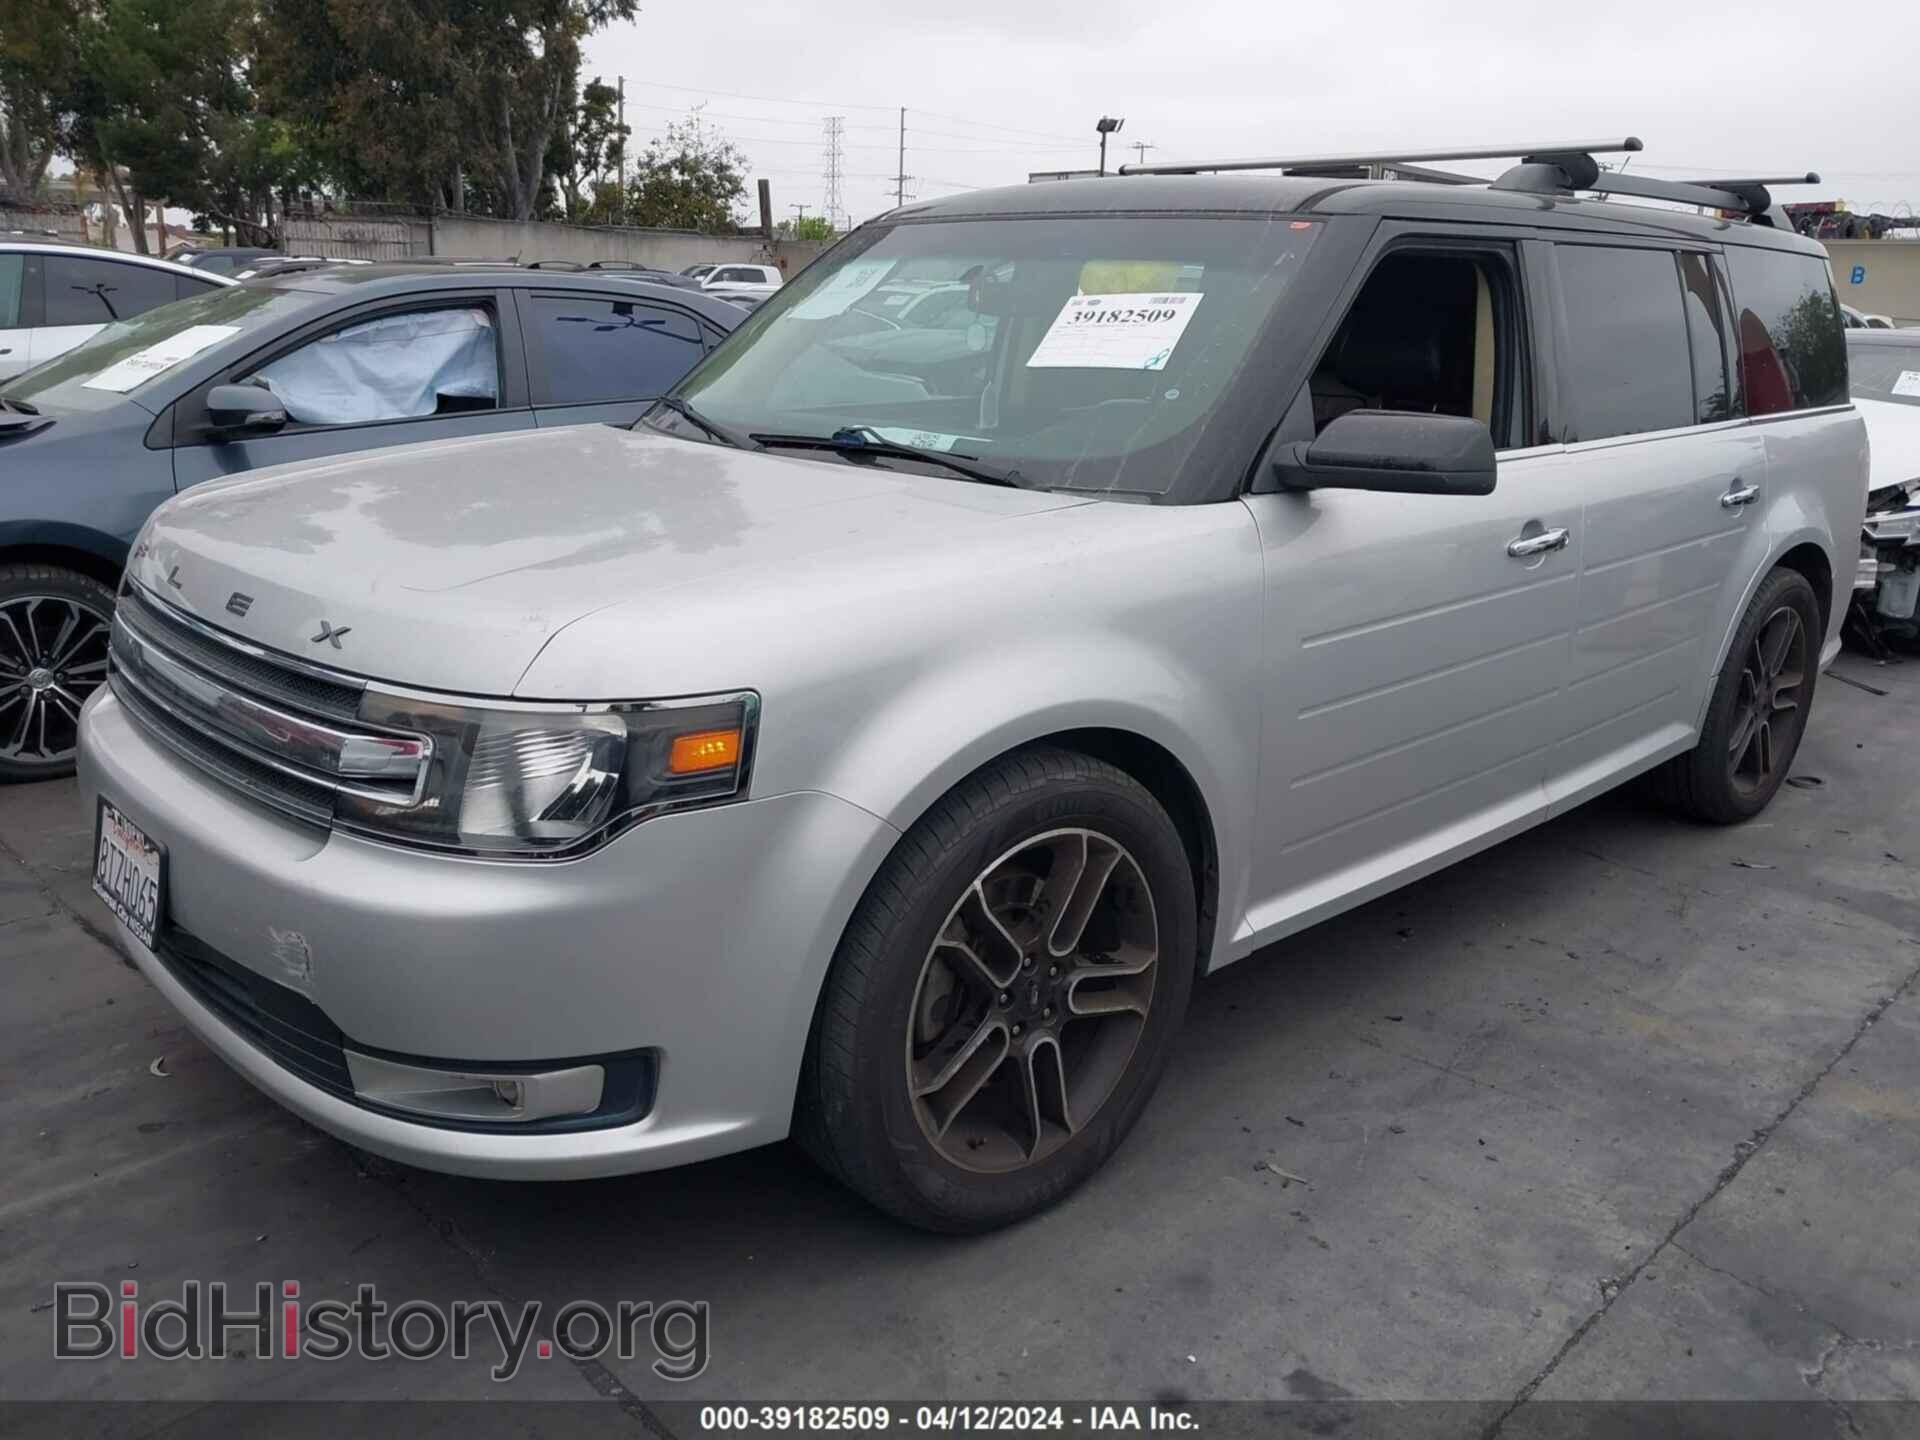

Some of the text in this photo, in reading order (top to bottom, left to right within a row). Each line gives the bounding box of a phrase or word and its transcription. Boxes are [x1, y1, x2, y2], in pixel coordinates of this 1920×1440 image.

[1851, 266, 1865, 284] B
[1067, 309, 1176, 325] 39182509
[98, 836, 157, 928] 8TZH065
